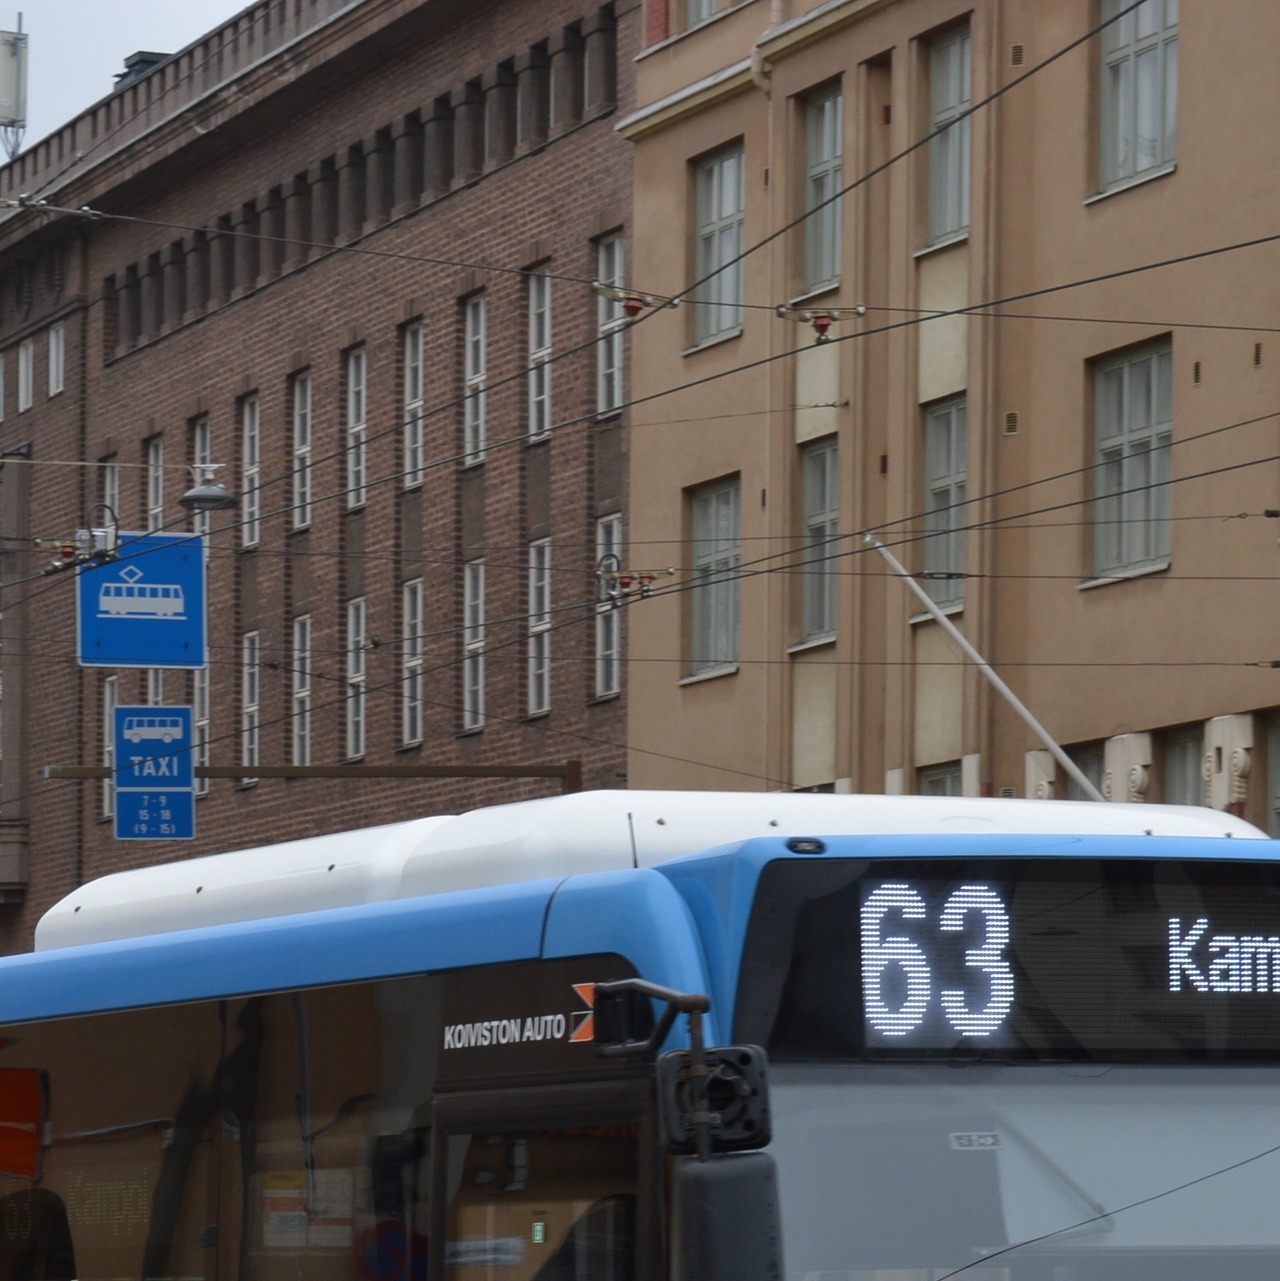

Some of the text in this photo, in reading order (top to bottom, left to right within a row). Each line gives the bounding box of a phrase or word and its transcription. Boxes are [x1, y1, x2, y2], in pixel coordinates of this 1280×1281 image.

[130, 756, 178, 776] TAXI
[142, 795, 149, 806] 7
[159, 795, 167, 806] 9
[859, 883, 1015, 1037] 63
[522, 1013, 566, 1042] AUTO
[67, 1166, 148, 1236] Kamppi
